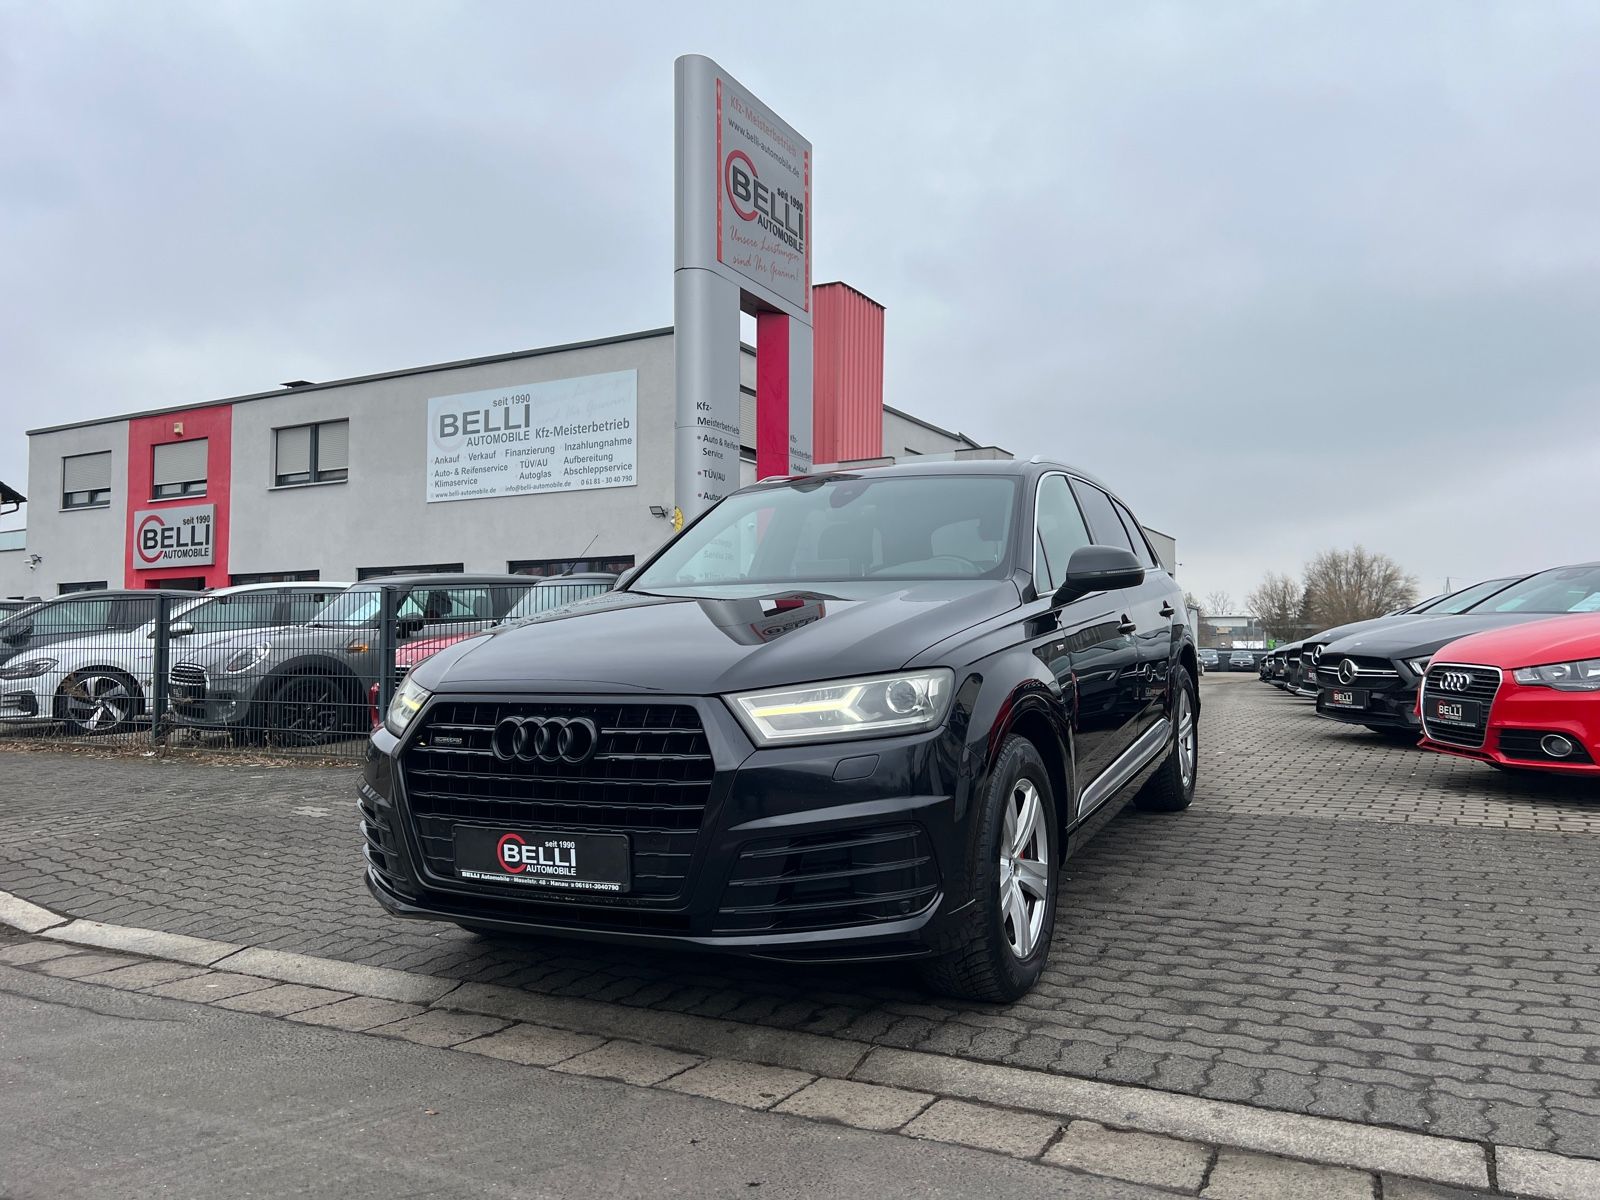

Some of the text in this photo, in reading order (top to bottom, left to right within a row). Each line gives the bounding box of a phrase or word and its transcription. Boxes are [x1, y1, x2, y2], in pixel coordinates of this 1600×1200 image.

[728, 117, 800, 178] www.belli-automobile.de
[732, 165, 803, 241] BELLI
[777, 187, 803, 212] seit 1990
[757, 213, 803, 254] AUTOMOBILE
[492, 393, 531, 407] seit 1990
[696, 401, 712, 411] Kfz-
[439, 404, 531, 438] BELLI
[697, 416, 740, 435] Meisterbetrieb
[535, 418, 630, 440] Kfz-Meisterbetrieb
[466, 430, 530, 447] AUTOMOBILE
[702, 434, 719, 446] Auto
[434, 437, 632, 465] Ankauf Verkauf Finanzierung Inzahlungnahme
[702, 447, 724, 460] Service
[520, 458, 548, 469] TÜV/AU
[563, 453, 613, 465] Aufbereitung
[434, 468, 452, 477] Auto-
[461, 463, 508, 475] Reifenservice
[519, 470, 552, 480] Autoglas
[563, 462, 632, 476] Abschleppservice
[434, 478, 478, 488] Klimaservice
[505, 481, 571, 492] info@belli-automobile.de
[183, 514, 210, 525] seit 1990
[143, 523, 210, 550] BELLI
[163, 547, 209, 559] AUTOMOBILE
[1438, 705, 1462, 717] BELLI
[544, 840, 575, 849] seit 1990
[503, 843, 576, 867] BELLI
[461, 871, 480, 879] BELLI
[481, 874, 510, 882] Automobile
[526, 864, 576, 876] AUTOMOBILE
